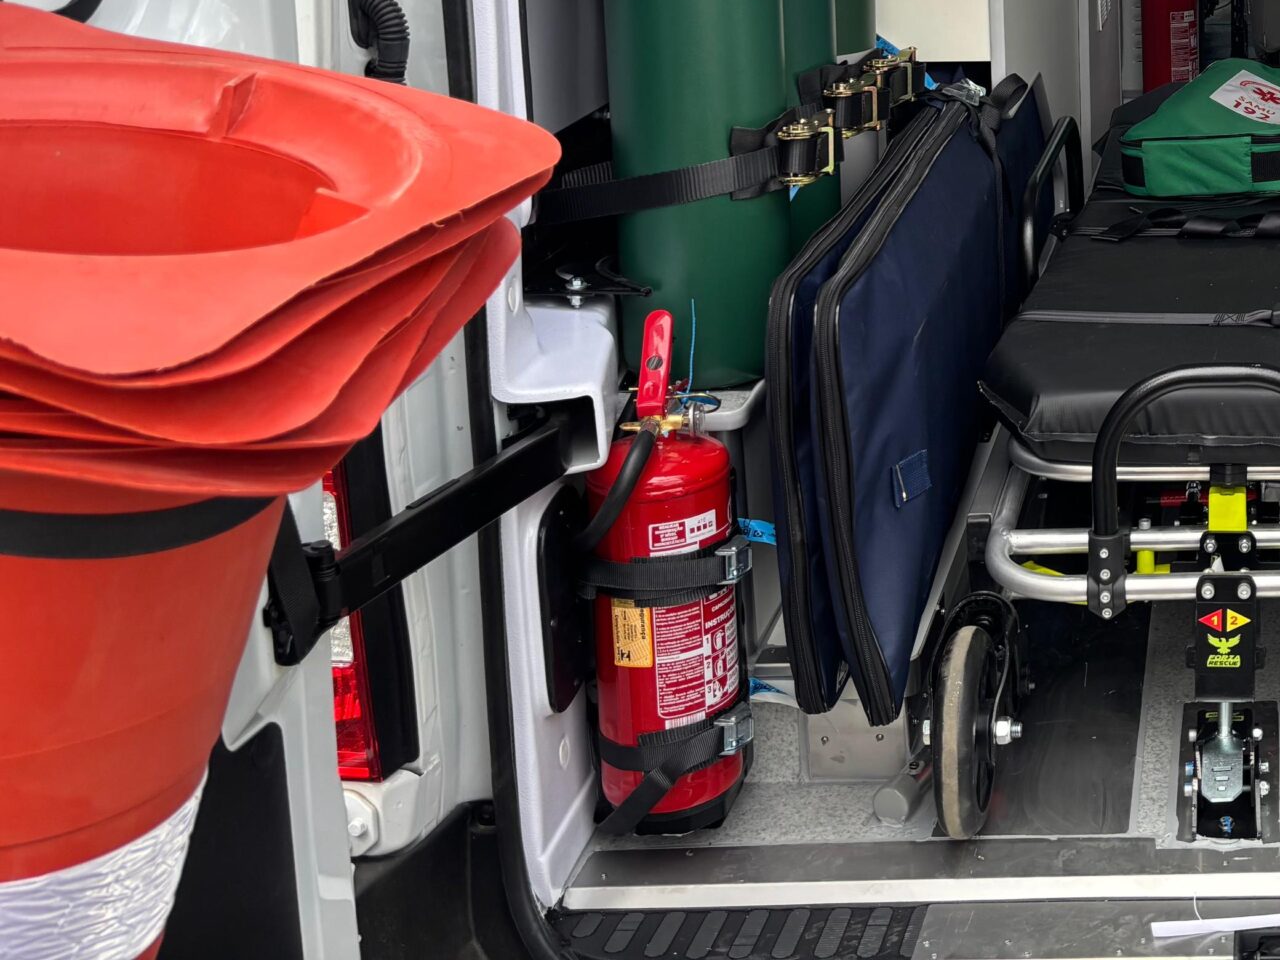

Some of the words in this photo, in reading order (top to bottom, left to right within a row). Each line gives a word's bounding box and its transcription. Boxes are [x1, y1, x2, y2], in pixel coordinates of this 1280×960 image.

[1233, 99, 1271, 121] 192
[1238, 95, 1276, 116] SAMU
[1210, 615, 1218, 626] 1
[1230, 616, 1238, 626] 2
